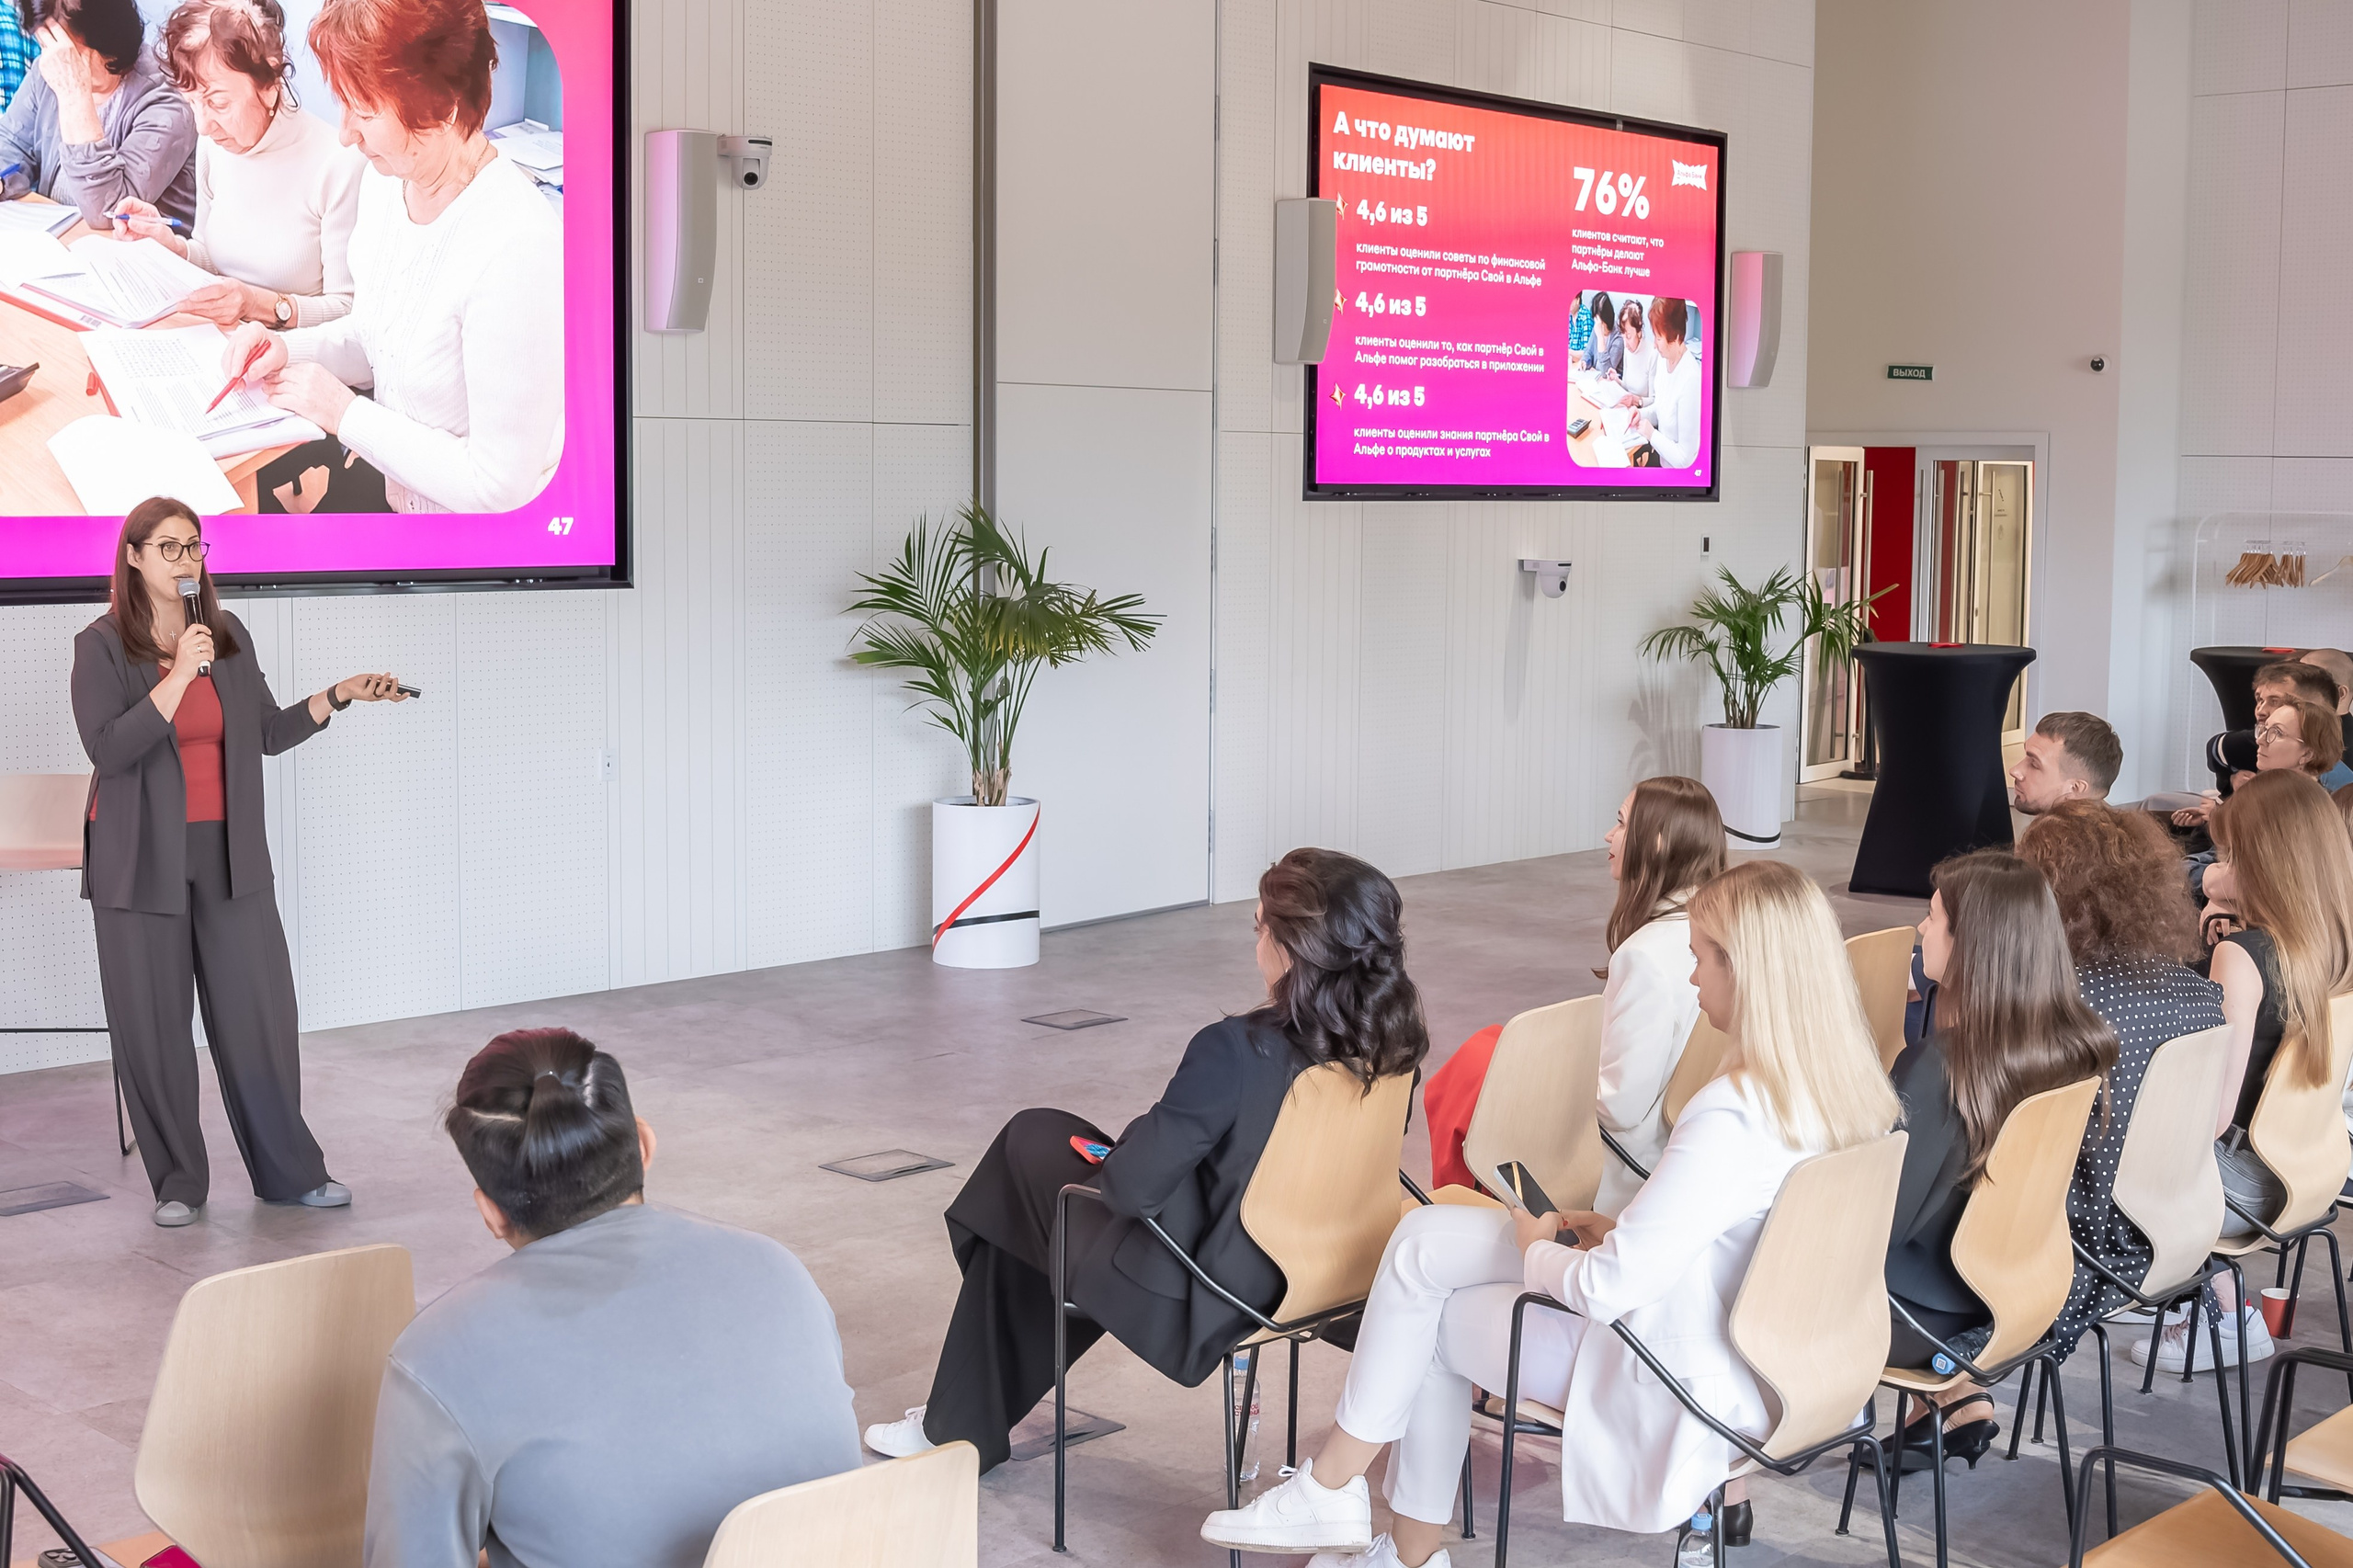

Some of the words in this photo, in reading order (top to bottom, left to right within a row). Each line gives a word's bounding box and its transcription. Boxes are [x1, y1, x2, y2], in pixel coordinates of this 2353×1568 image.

[1333, 111, 1350, 135] А
[1354, 119, 1391, 140] что
[1394, 125, 1475, 152] думают
[1334, 152, 1436, 181] клиенты?
[1573, 166, 1650, 220] 76%
[1356, 199, 1386, 226] 4,6
[1391, 207, 1413, 225] из
[1416, 206, 1427, 227] 5
[1572, 229, 1611, 242] клиентов
[1612, 233, 1648, 248] считают,
[1650, 238, 1664, 247] что
[1356, 243, 1398, 256] клиенты
[1400, 247, 1441, 260] оценили
[1443, 251, 1476, 263] советы
[1478, 255, 1489, 265] по
[1491, 254, 1546, 270] финансовой
[1572, 244, 1613, 259] партнёры
[1614, 250, 1644, 261] делают
[1356, 260, 1420, 275] грамотности
[1421, 266, 1432, 276] от
[1434, 268, 1479, 282] партнёра
[1481, 269, 1504, 283] Свой
[1506, 275, 1512, 284] в
[1513, 273, 1542, 288] Альфе
[1571, 258, 1623, 274] Альфа-Банк
[1624, 266, 1650, 278] лучше
[1355, 291, 1385, 317] 4,6
[1389, 298, 1411, 315] из
[1415, 296, 1427, 317] 5
[1355, 335, 1397, 347] клиенты
[1398, 339, 1439, 351] оценили
[1441, 341, 1455, 353] то,
[1456, 342, 1473, 352] как
[1475, 343, 1512, 357] партнёр
[1514, 343, 1537, 356] Свой
[1538, 347, 1544, 357] в
[1354, 351, 1387, 367] Альфе
[1388, 355, 1418, 365] помог
[1420, 356, 1480, 370] разобраться
[1482, 360, 1487, 369] в
[1489, 362, 1545, 373] приложении
[1893, 368, 1926, 378] ВЫХОД
[1354, 384, 1384, 409] 4,6
[1388, 389, 1410, 406] из
[1414, 386, 1426, 407] 5
[1353, 427, 1395, 438] клиенты
[1397, 429, 1438, 440] оценили
[1440, 430, 1473, 440] знания
[1475, 430, 1518, 443] партнёра
[1519, 430, 1542, 442] Свой
[1544, 433, 1550, 442] в
[1353, 443, 1386, 458] Альфе
[1387, 445, 1393, 455] о
[1395, 446, 1445, 458] продуктах
[1447, 447, 1453, 456] и
[1455, 447, 1491, 459] услугах
[547, 517, 574, 535] 47
